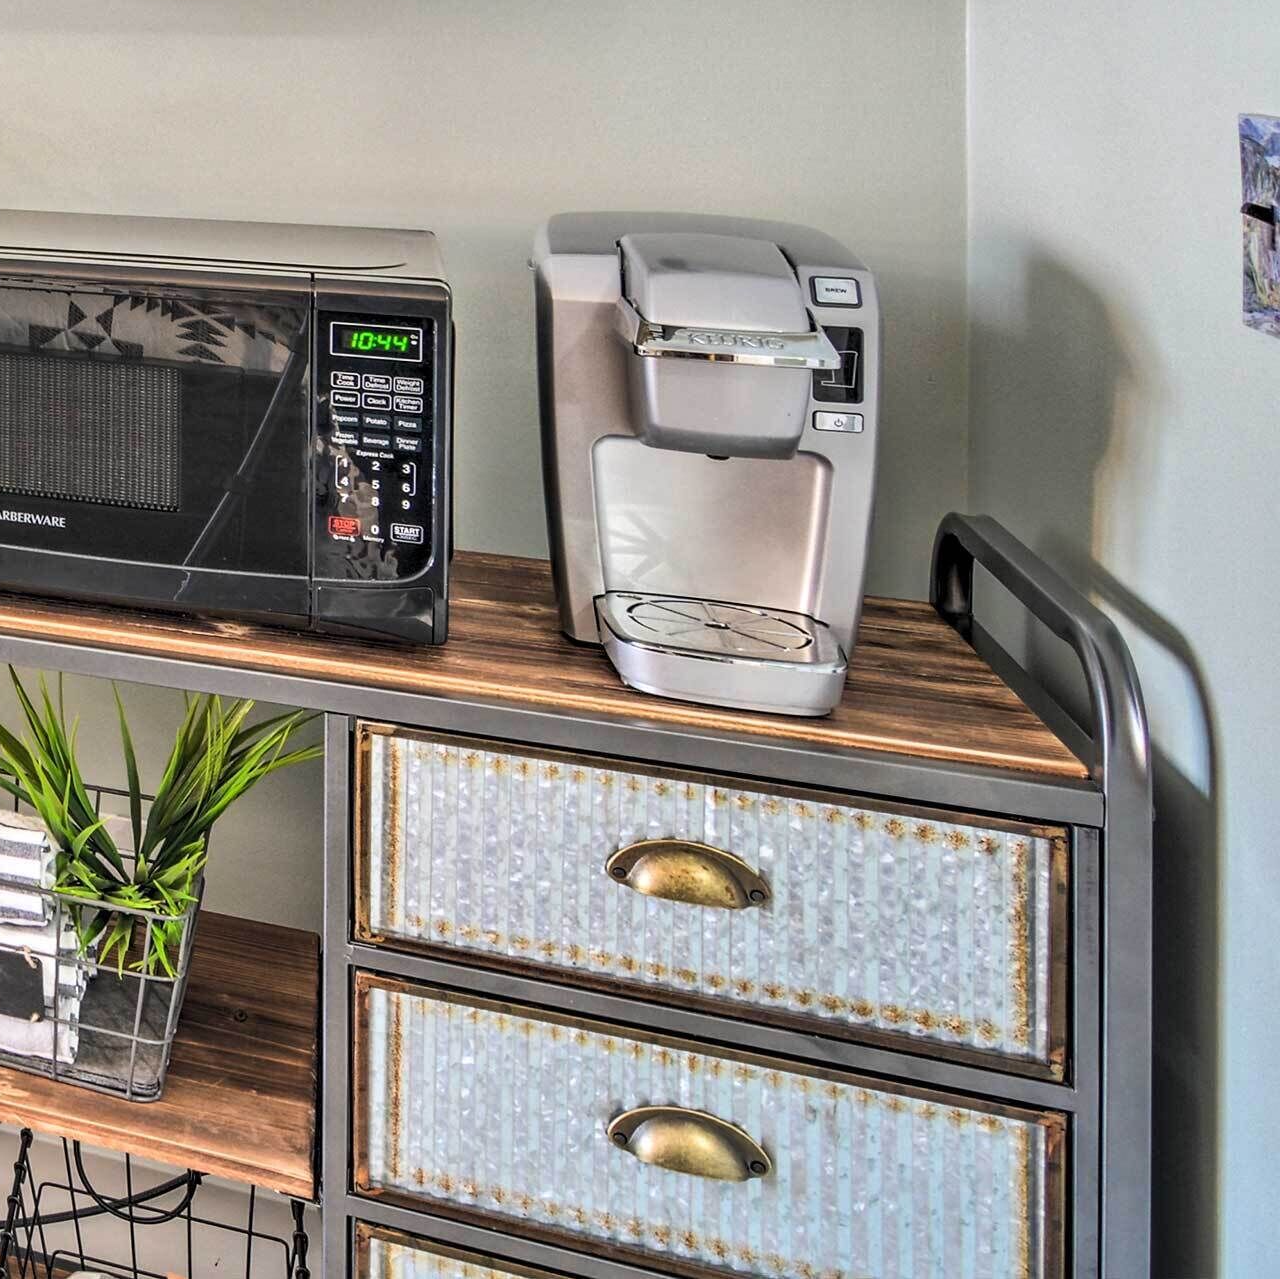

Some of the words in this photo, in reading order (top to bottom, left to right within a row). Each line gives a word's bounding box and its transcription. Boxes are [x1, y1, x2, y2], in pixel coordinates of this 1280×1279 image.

[825, 287, 848, 295] BREW
[351, 332, 408, 352] 10:44
[689, 332, 785, 350] KEURIG
[335, 394, 356, 402] Power
[367, 397, 386, 405] Clock
[332, 414, 358, 423] Popcorn
[365, 417, 388, 425] Potato
[398, 420, 417, 428] Pizza
[356, 449, 379, 458] Express
[379, 451, 394, 459] Cook
[340, 458, 348, 468] 1
[371, 461, 380, 471] 2
[402, 464, 411, 474] 3
[340, 477, 349, 487] 4
[371, 480, 380, 490] 5
[402, 483, 410, 493] 6
[340, 493, 349, 503] 7
[371, 495, 380, 507] 8
[402, 499, 410, 510] 9
[370, 524, 380, 535] 0
[394, 526, 419, 536] START
